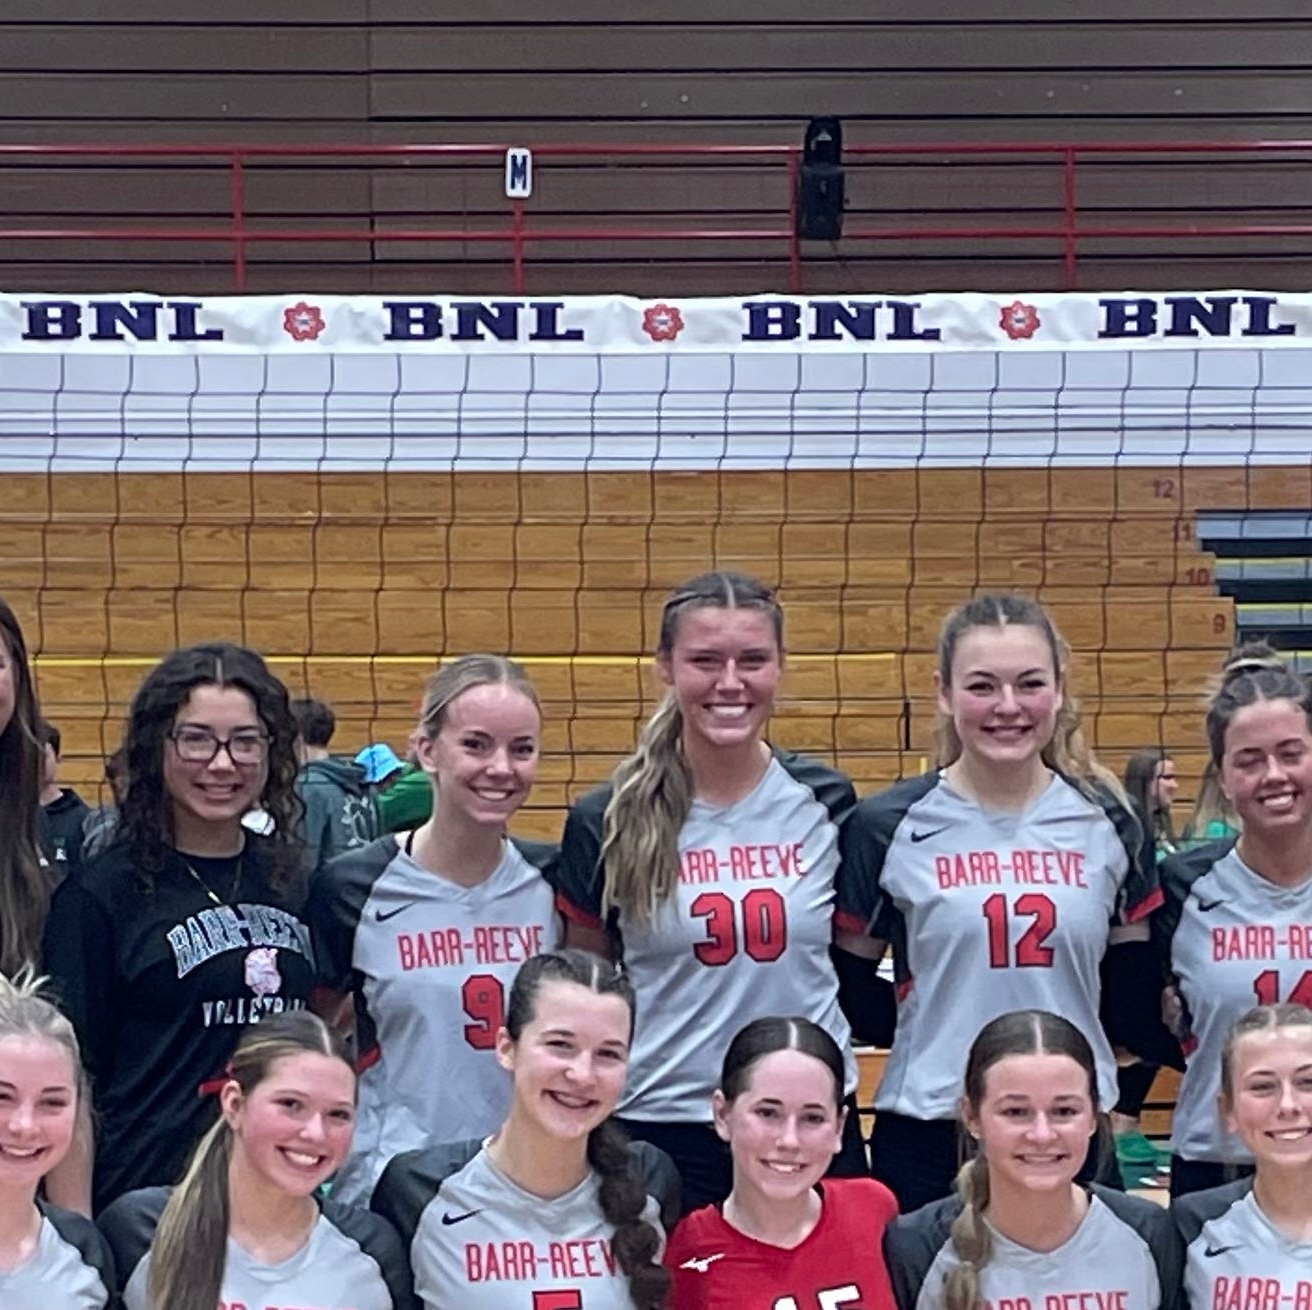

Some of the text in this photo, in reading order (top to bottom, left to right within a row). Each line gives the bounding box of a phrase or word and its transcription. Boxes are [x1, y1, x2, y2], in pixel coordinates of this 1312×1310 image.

[510, 154, 528, 190] M
[22, 303, 223, 341] BNL
[383, 303, 583, 341] BNL
[742, 302, 940, 340] BNL
[1099, 297, 1295, 338] BNL
[1153, 479, 1175, 499] 12
[676, 844, 808, 886] ARR-REEVE
[936, 850, 1088, 890] BARR-REEVE
[690, 888, 787, 967] 30
[982, 893, 1057, 969] 12
[462, 974, 505, 1051] 9
[465, 1240, 618, 1282] BARR-REEV
